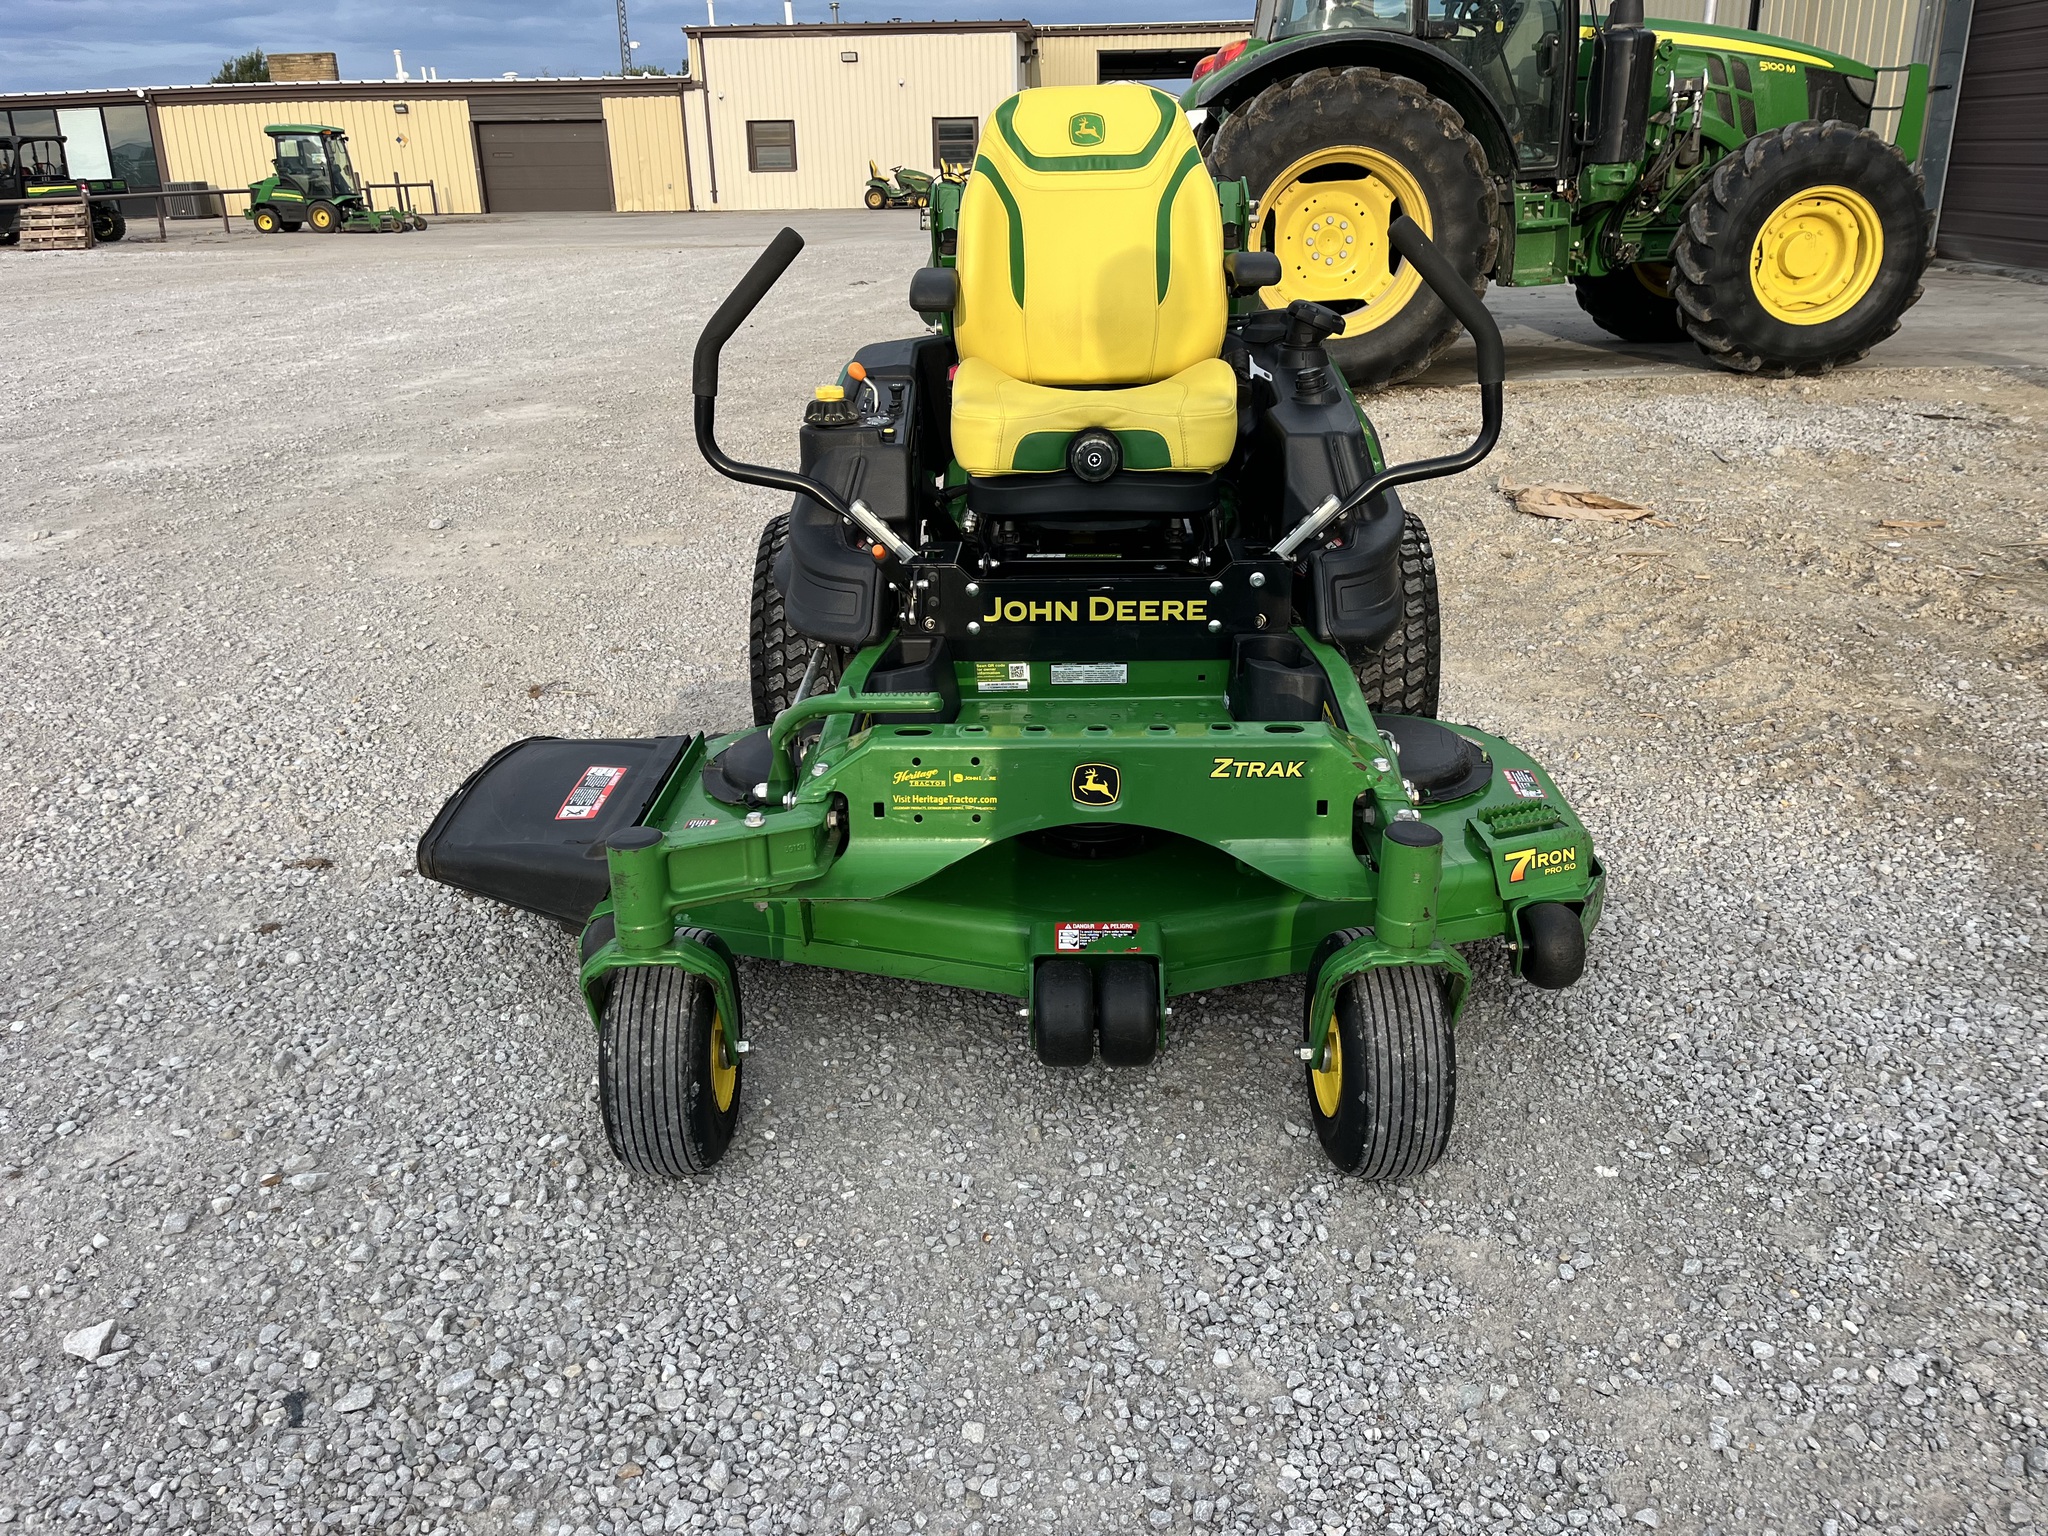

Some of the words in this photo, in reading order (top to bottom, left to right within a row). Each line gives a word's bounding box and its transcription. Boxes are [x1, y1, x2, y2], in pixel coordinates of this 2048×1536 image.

[1760, 61, 1785, 72] 5100
[1786, 64, 1796, 74] M
[984, 596, 1078, 622] JOHN
[1089, 596, 1208, 622] DEERE
[1209, 757, 1307, 778] ZTRAK
[892, 768, 939, 784] Heritage
[892, 795, 910, 803] Visit
[912, 795, 998, 805] HeritageTractor.com
[1545, 866, 1562, 875] PRO
